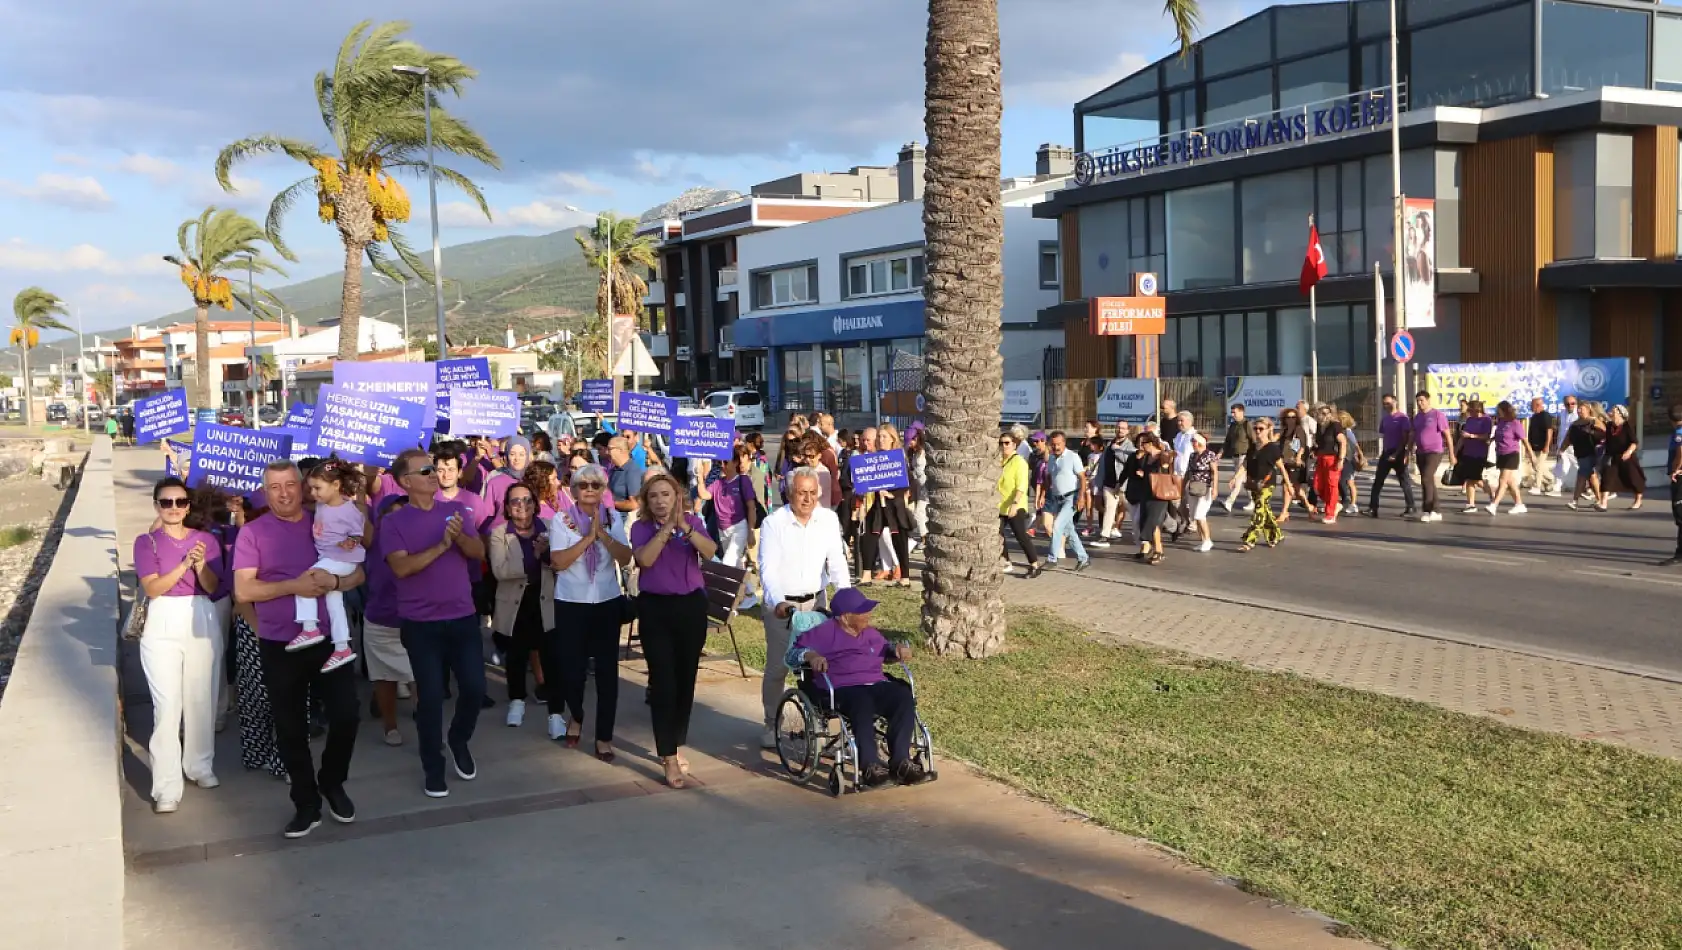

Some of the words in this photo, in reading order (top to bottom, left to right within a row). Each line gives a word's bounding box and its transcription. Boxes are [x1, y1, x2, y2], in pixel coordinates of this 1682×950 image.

[1095, 145, 1167, 178] YÜKSEK
[1169, 112, 1306, 166] PERFORMANS
[842, 315, 884, 331] HALKBANK
[1101, 308, 1163, 319] PERFORMANS
[327, 391, 368, 409] HERKES
[370, 400, 400, 416] UZUN
[321, 414, 346, 427] AMA
[347, 419, 381, 435] KİMSE
[325, 403, 378, 423] YAŞAMAK
[378, 412, 410, 430] İSTER
[688, 420, 704, 430] YAŞ
[705, 421, 718, 430] DA
[206, 428, 279, 451] UNUTMANIN
[320, 425, 387, 448] YAŞLANMAK
[673, 437, 729, 449] SAKLANAMAZ
[674, 428, 700, 438] SEVGİ
[196, 441, 283, 465] KARANLIĞIND
[317, 434, 366, 455] İSTEMEZ
[198, 457, 226, 471] ONU
